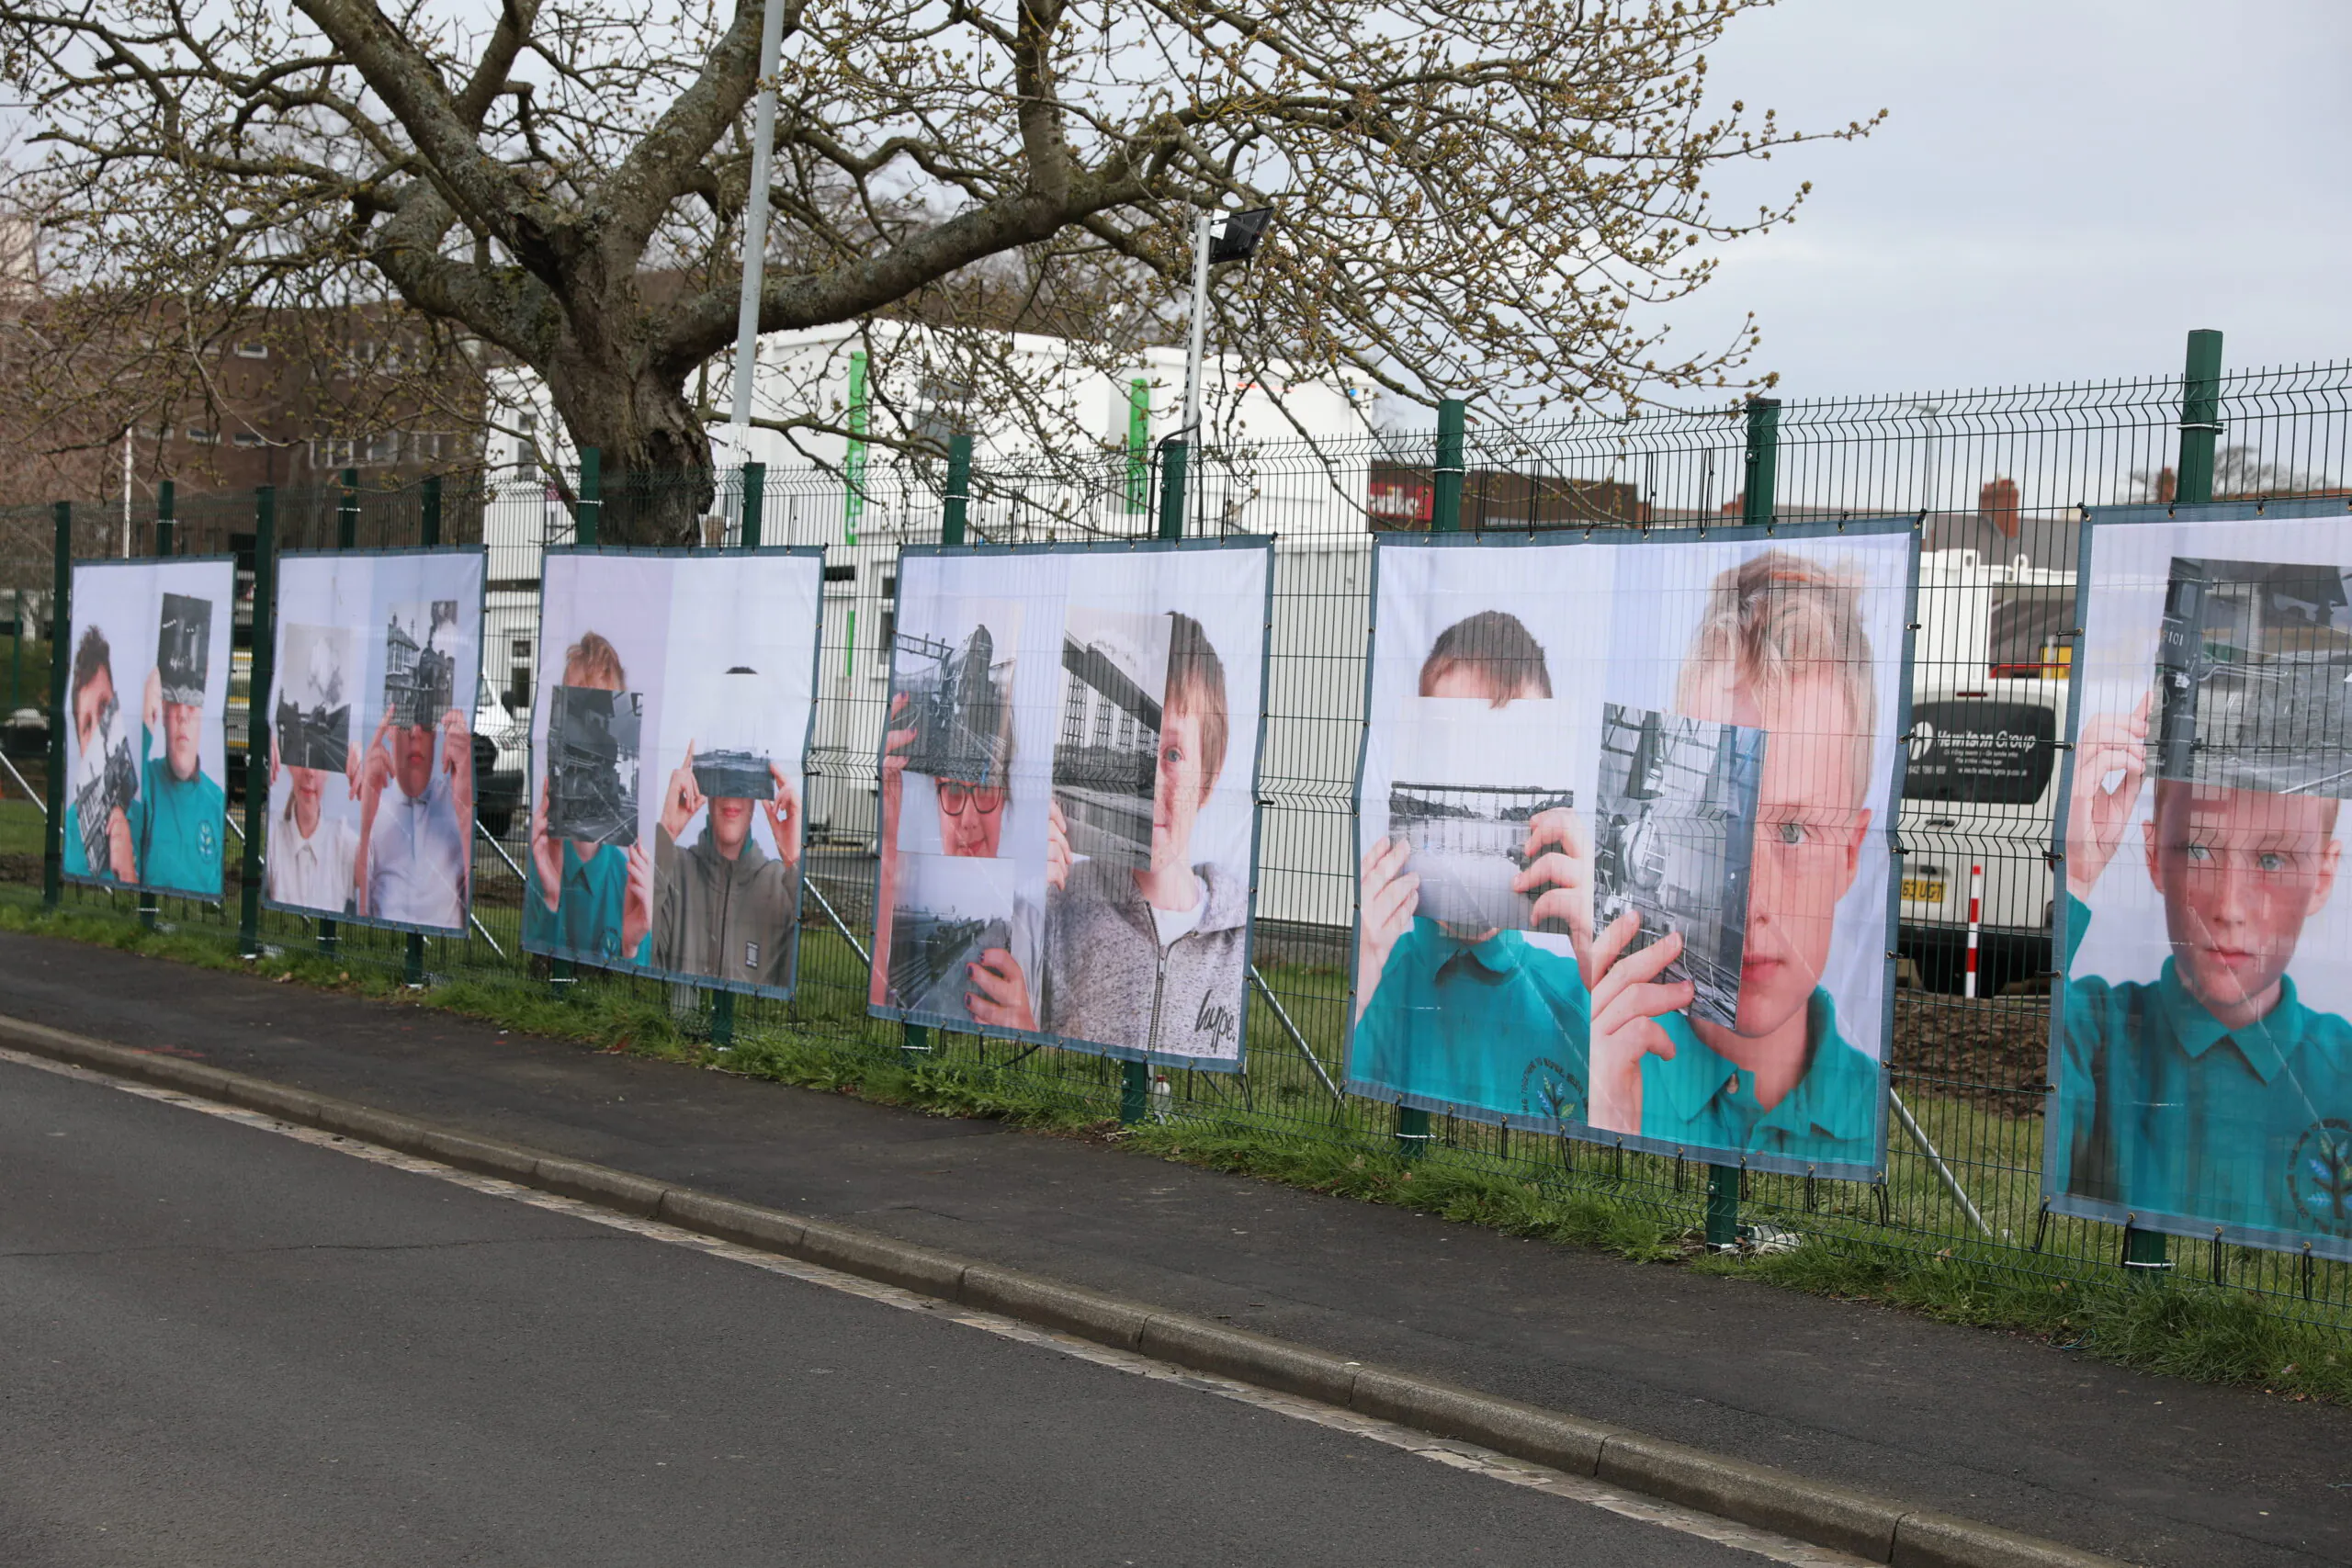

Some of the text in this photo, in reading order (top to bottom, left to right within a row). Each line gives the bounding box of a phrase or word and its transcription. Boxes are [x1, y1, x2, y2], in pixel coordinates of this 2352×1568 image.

[1937, 730, 2036, 753] Hewitson Group
[1902, 882, 1917, 897] 63
